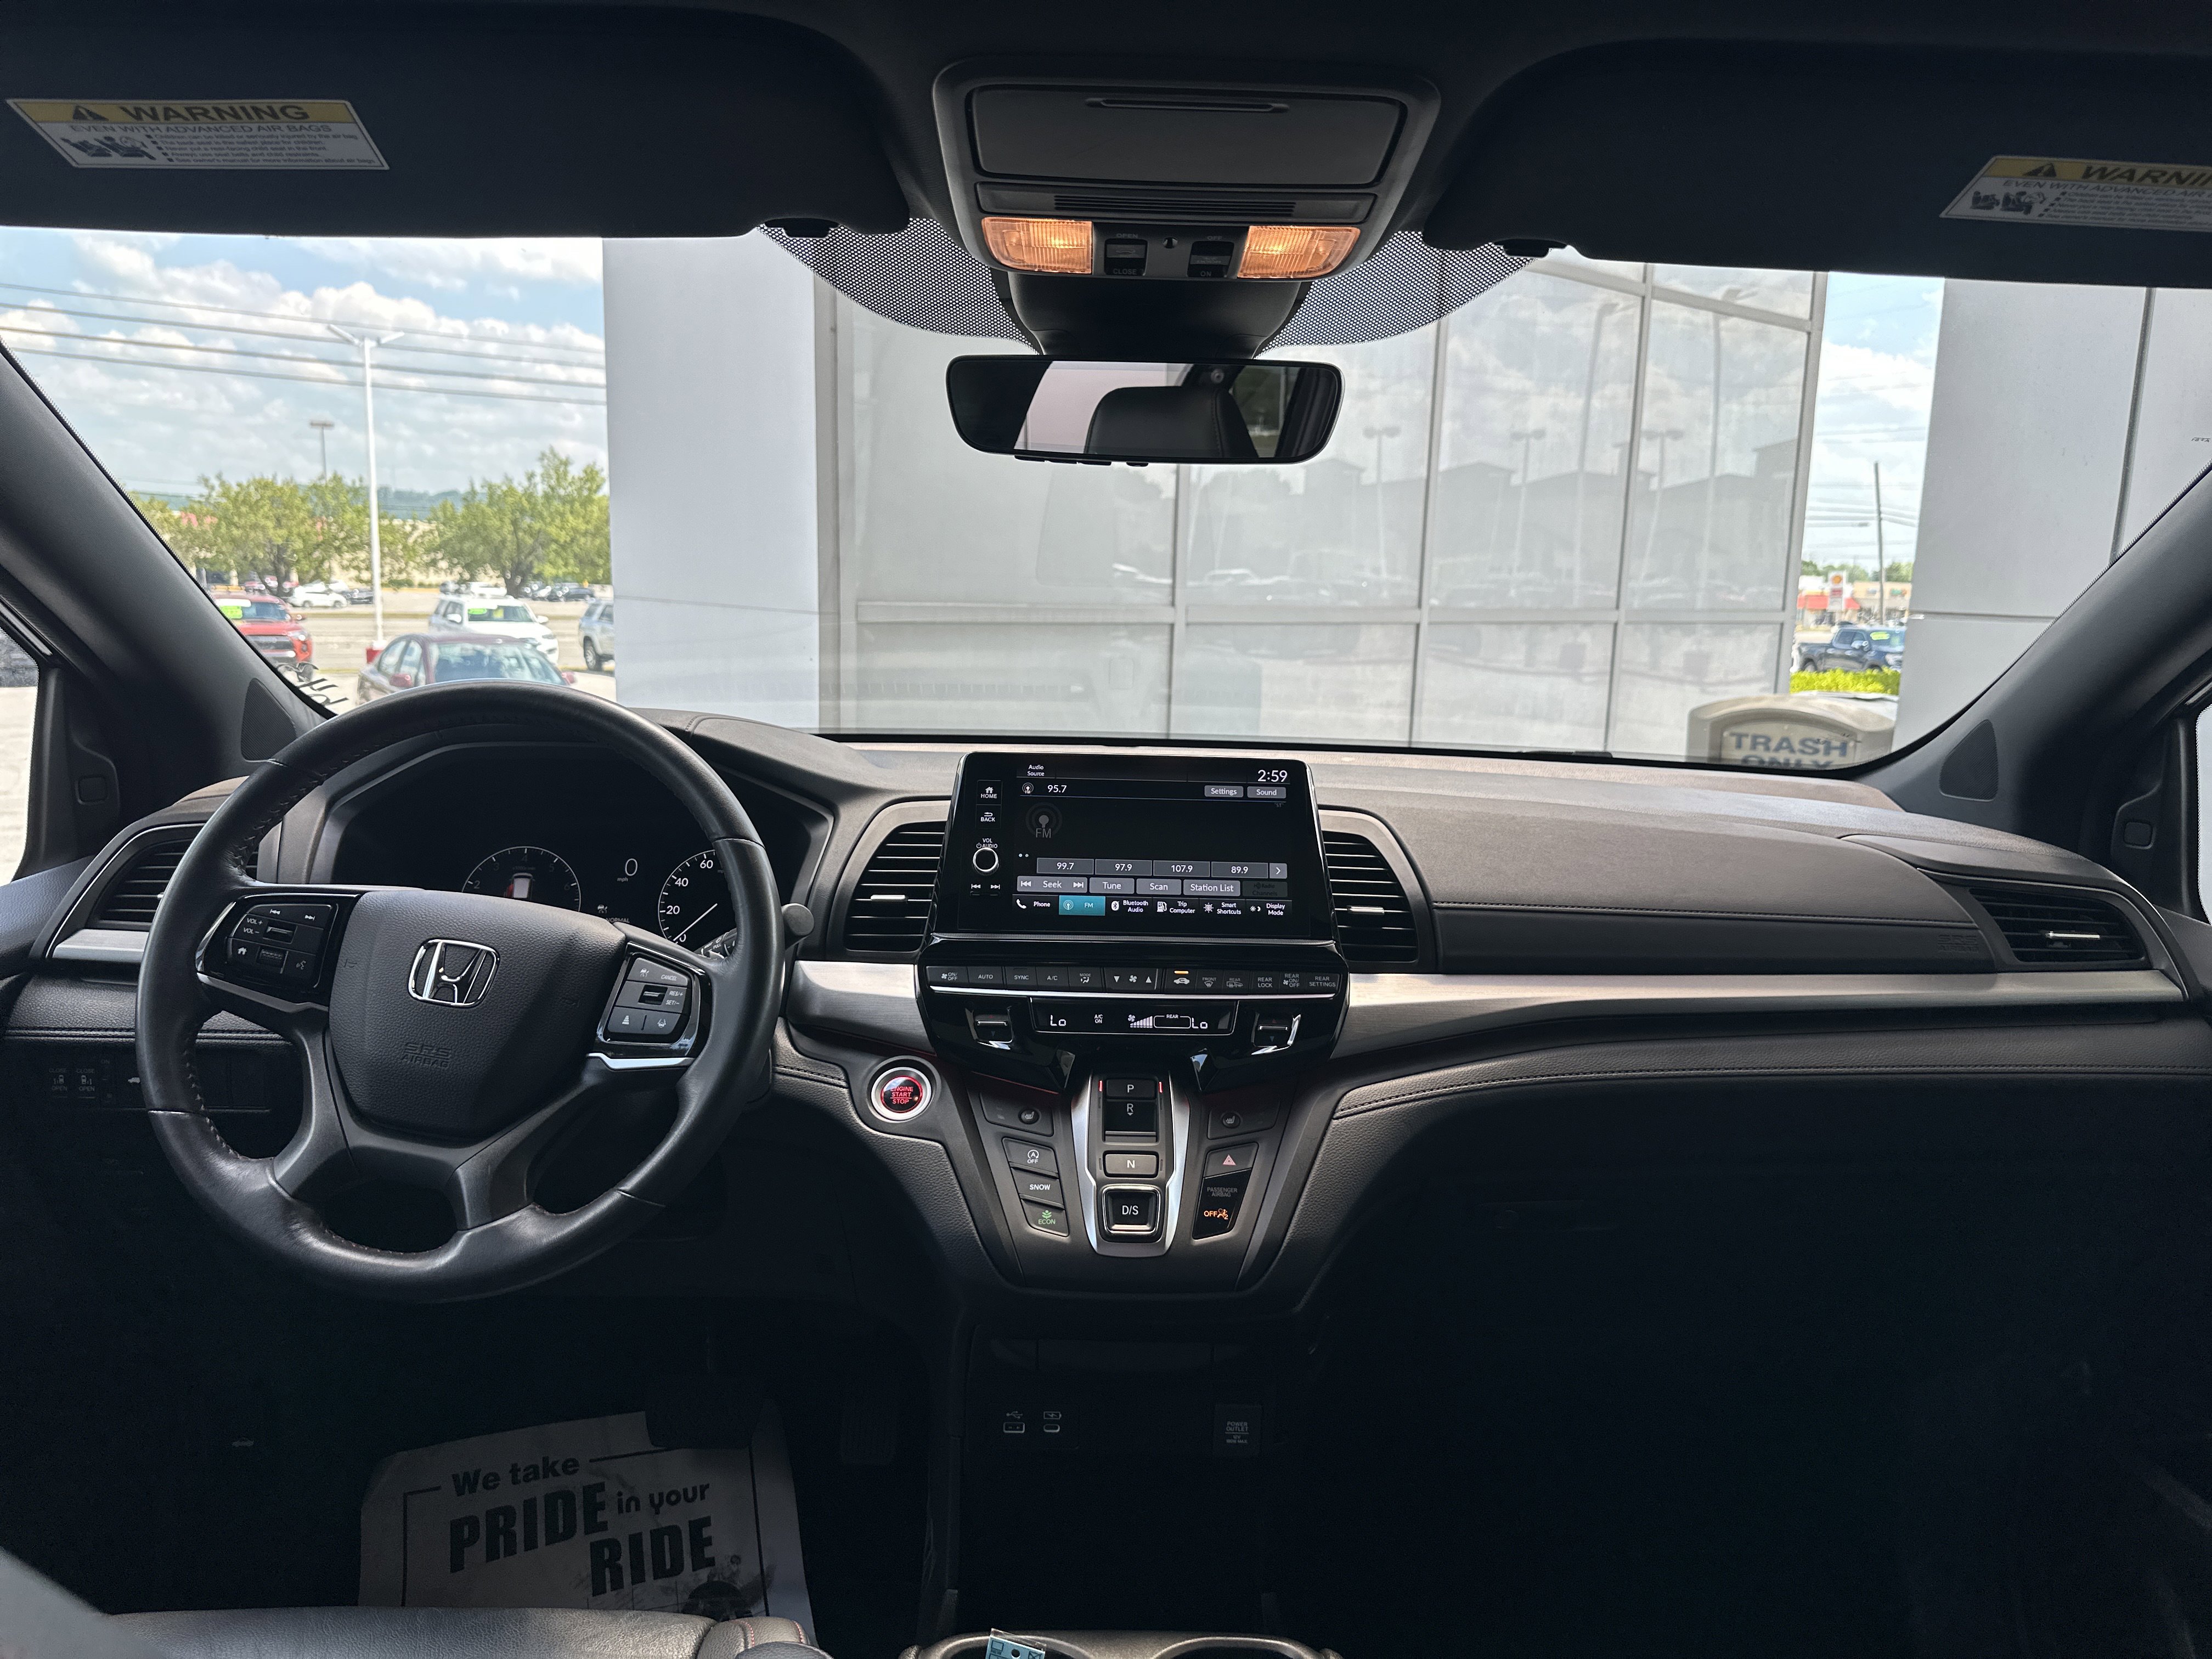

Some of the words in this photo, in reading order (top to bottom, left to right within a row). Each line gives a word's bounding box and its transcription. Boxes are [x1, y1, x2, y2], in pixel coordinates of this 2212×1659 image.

[119, 105, 309, 121] WARNING
[2003, 180, 2046, 188] EVEN
[2049, 182, 2089, 190] WITH
[2090, 185, 2176, 195] ADVANCED
[1729, 732, 1848, 757] TRASH
[1257, 770, 1288, 782] 2:59
[1211, 788, 1237, 796] Settings
[1035, 828, 1052, 838] FM
[494, 862, 500, 871] 3
[549, 865, 555, 873] 5
[624, 858, 638, 877] 0
[700, 860, 714, 869] 60
[1171, 865, 1193, 873] 107.9
[474, 880, 481, 889] 2
[564, 882, 570, 891] 6
[675, 878, 689, 887] 40
[1043, 881, 1062, 889] Seek
[1190, 884, 1218, 892] Station
[666, 905, 680, 915] 20
[403, 1042, 452, 1059] SRS
[400, 1054, 449, 1069] AIRBAG
[1127, 1084, 1135, 1093] P
[1126, 1103, 1133, 1113] R
[1127, 1160, 1135, 1168] N
[1122, 1205, 1139, 1215] D/S
[452, 1468, 501, 1497] We
[510, 1455, 580, 1485] take
[450, 1482, 609, 1573] PRIDE
[617, 1491, 641, 1514] in
[648, 1483, 710, 1515] your
[590, 1516, 715, 1596] RIDE
